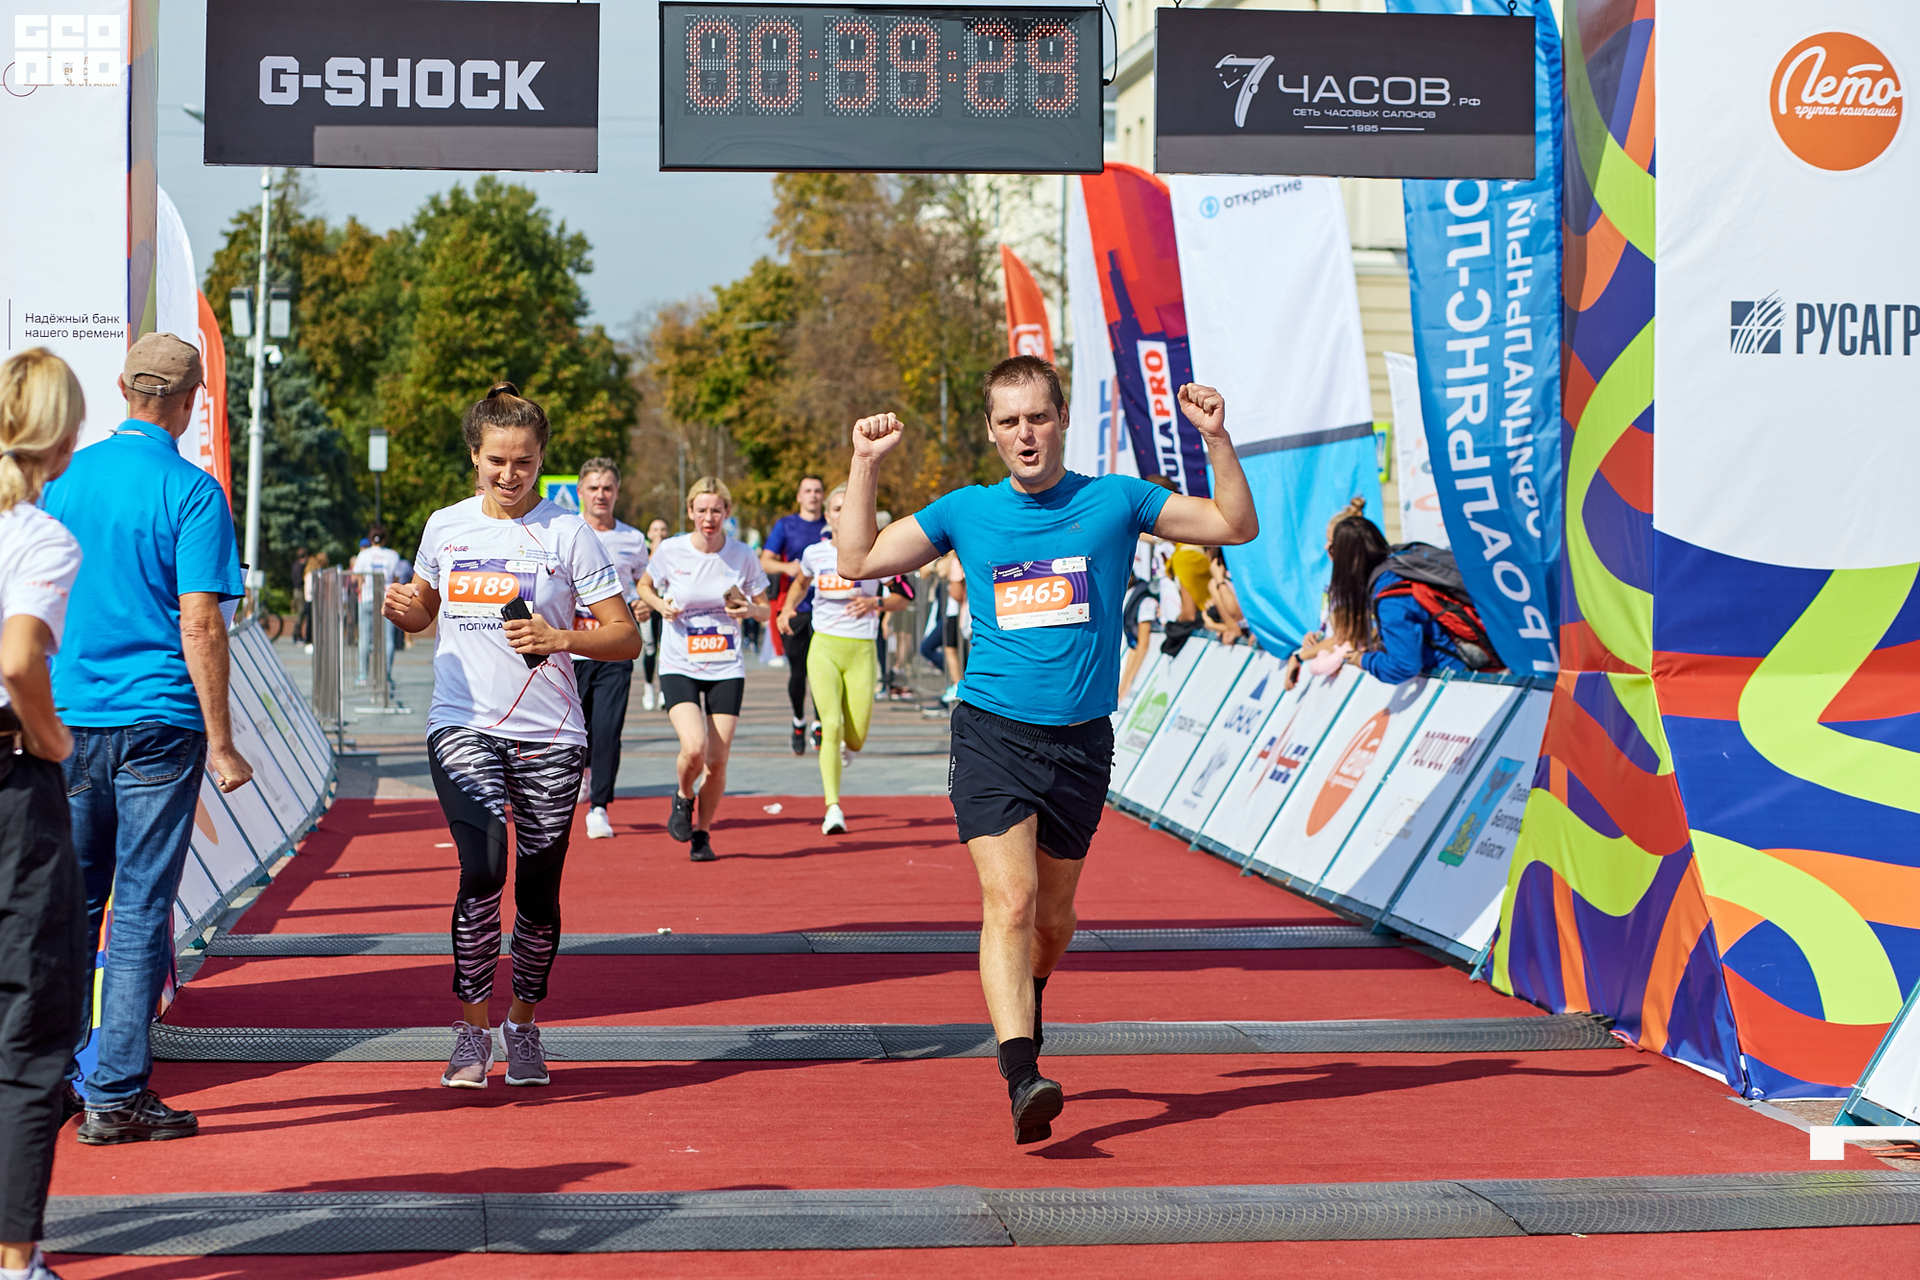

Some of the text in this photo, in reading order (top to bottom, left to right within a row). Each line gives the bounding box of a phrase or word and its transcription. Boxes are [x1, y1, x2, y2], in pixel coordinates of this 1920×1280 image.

[258, 55, 546, 111] G-SHOCK
[1778, 45, 1904, 115] Лето
[1215, 54, 1275, 128] 7
[1292, 108, 1437, 119] СЕТЬ ЧАСОВЫХ САЛОНОВ
[1794, 105, 1898, 120] группа компаний
[1350, 124, 1379, 132] 1995
[1223, 178, 1303, 209] открытие
[25, 312, 120, 325] Надёжный банк
[25, 329, 124, 340] нашего времени
[454, 575, 515, 597] 5189
[1002, 580, 1066, 608] 5465
[691, 636, 726, 651] 5087
